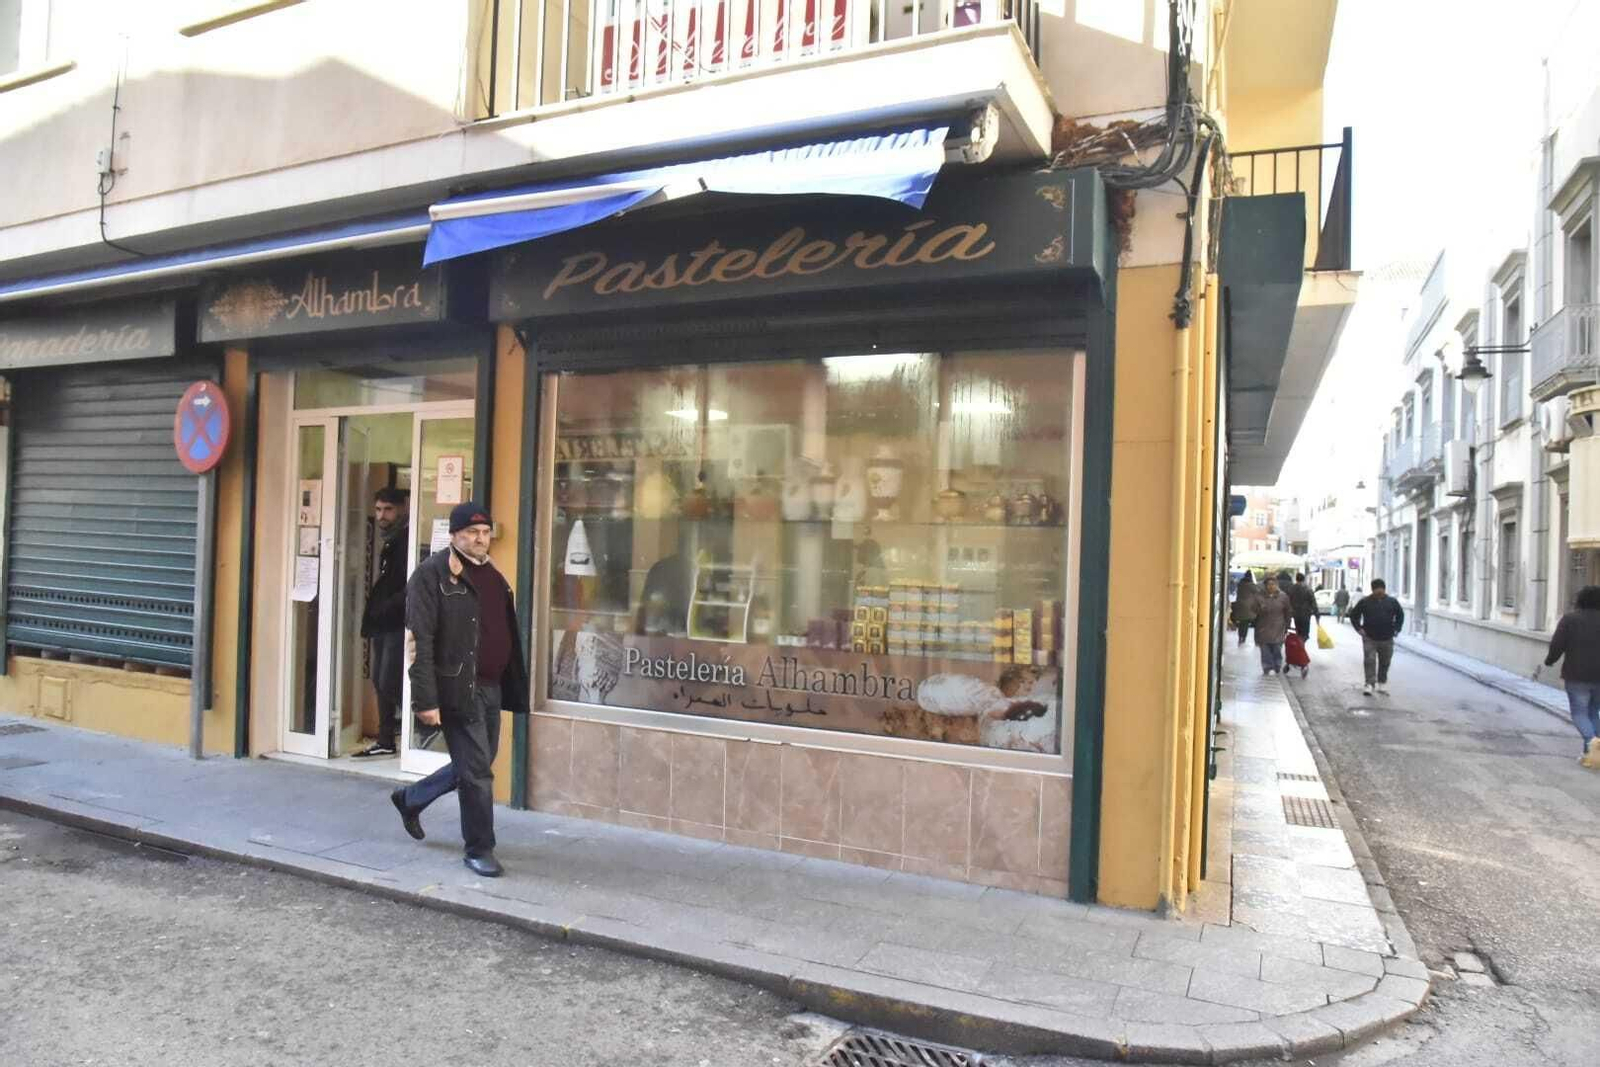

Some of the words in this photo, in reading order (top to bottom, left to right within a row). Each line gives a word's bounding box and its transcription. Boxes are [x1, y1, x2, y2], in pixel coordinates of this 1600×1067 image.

[543, 218, 996, 300] Pastelería
[286, 269, 422, 319] Alhambra
[0, 324, 151, 358] anadería
[623, 647, 746, 687] Pastelería
[757, 655, 916, 701] Alhambra
